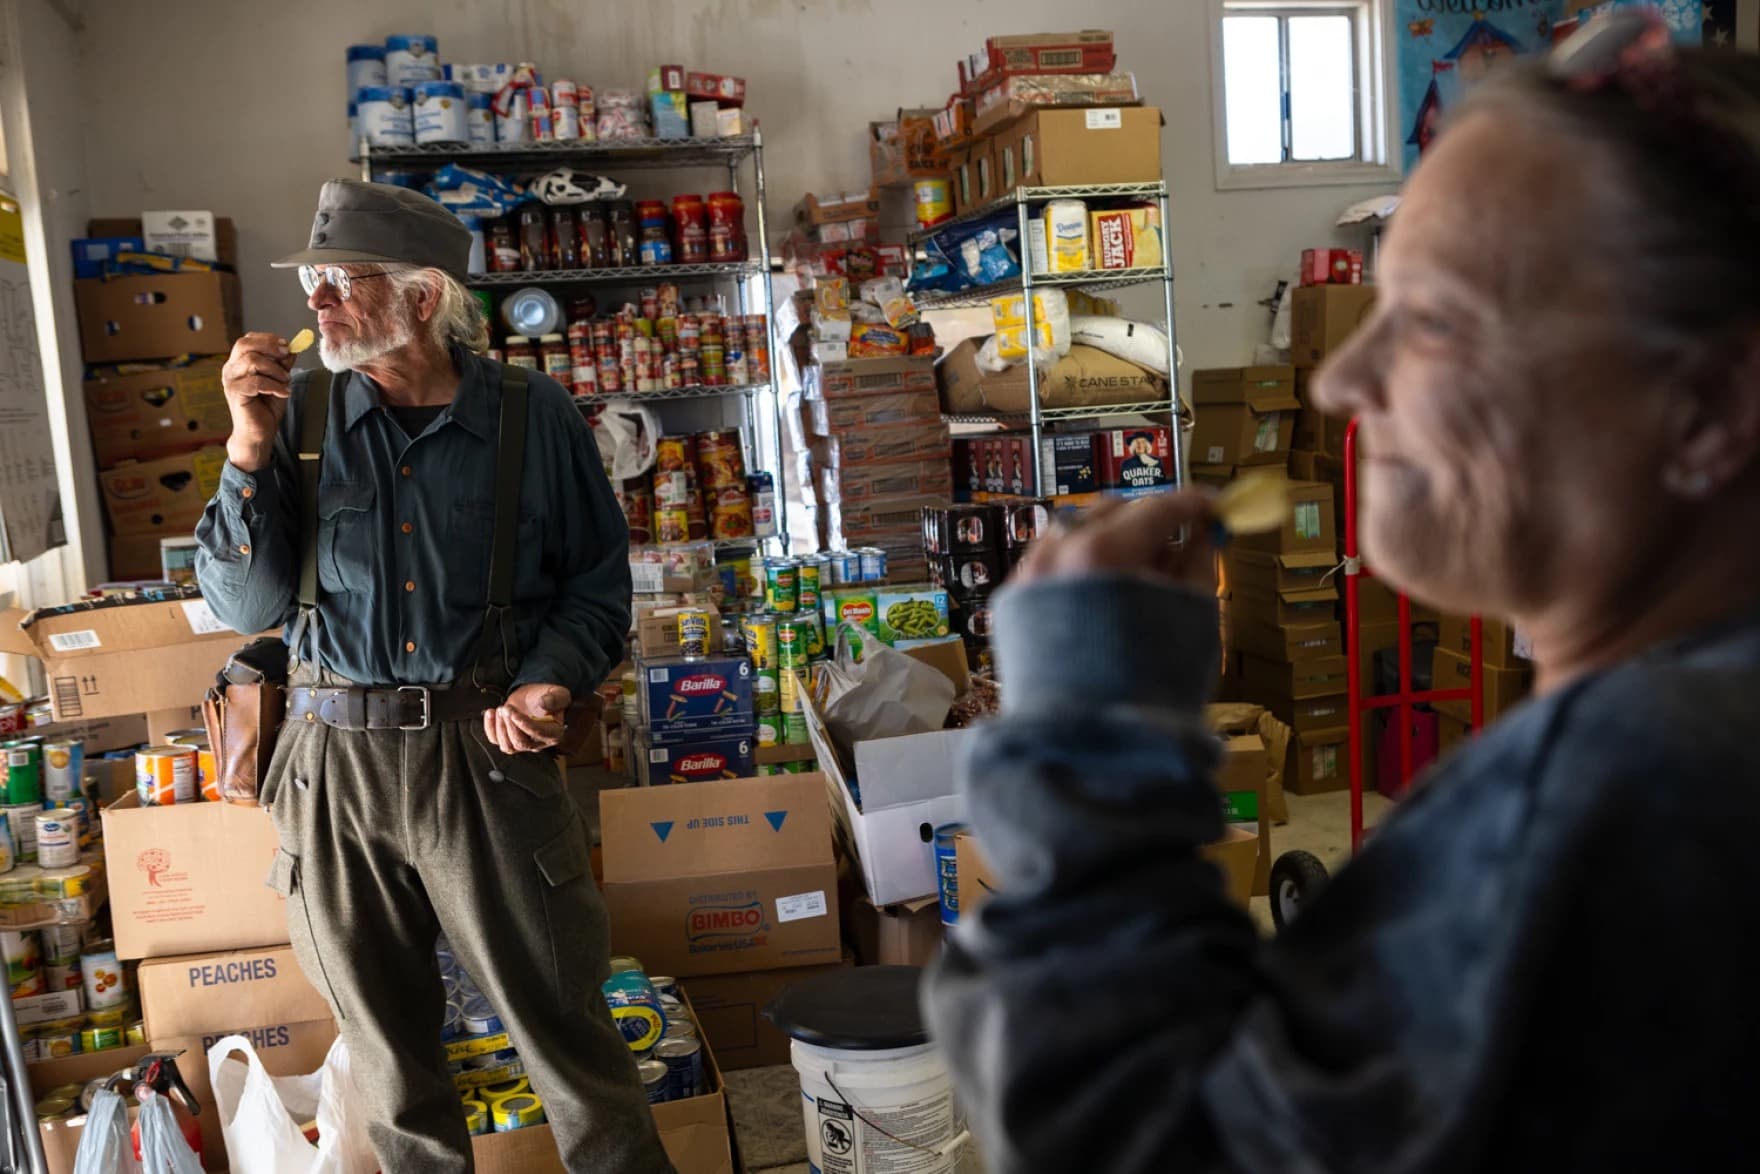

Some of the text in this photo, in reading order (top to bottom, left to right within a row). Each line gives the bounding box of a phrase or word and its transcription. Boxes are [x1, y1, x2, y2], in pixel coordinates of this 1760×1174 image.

[1101, 220, 1112, 267] HUNGRY
[1110, 216, 1125, 267] JACK
[1122, 466, 1162, 480] QUAKER
[1132, 476, 1155, 487] OATS
[739, 662, 749, 676] 6
[680, 678, 722, 692] Barilla
[739, 741, 749, 755] 6
[680, 757, 722, 772] Barilla
[687, 815, 750, 829] THIS SIDE UP
[692, 909, 761, 932] BIMBO
[189, 958, 277, 988] PEACHES
[202, 1025, 290, 1056] PHES
